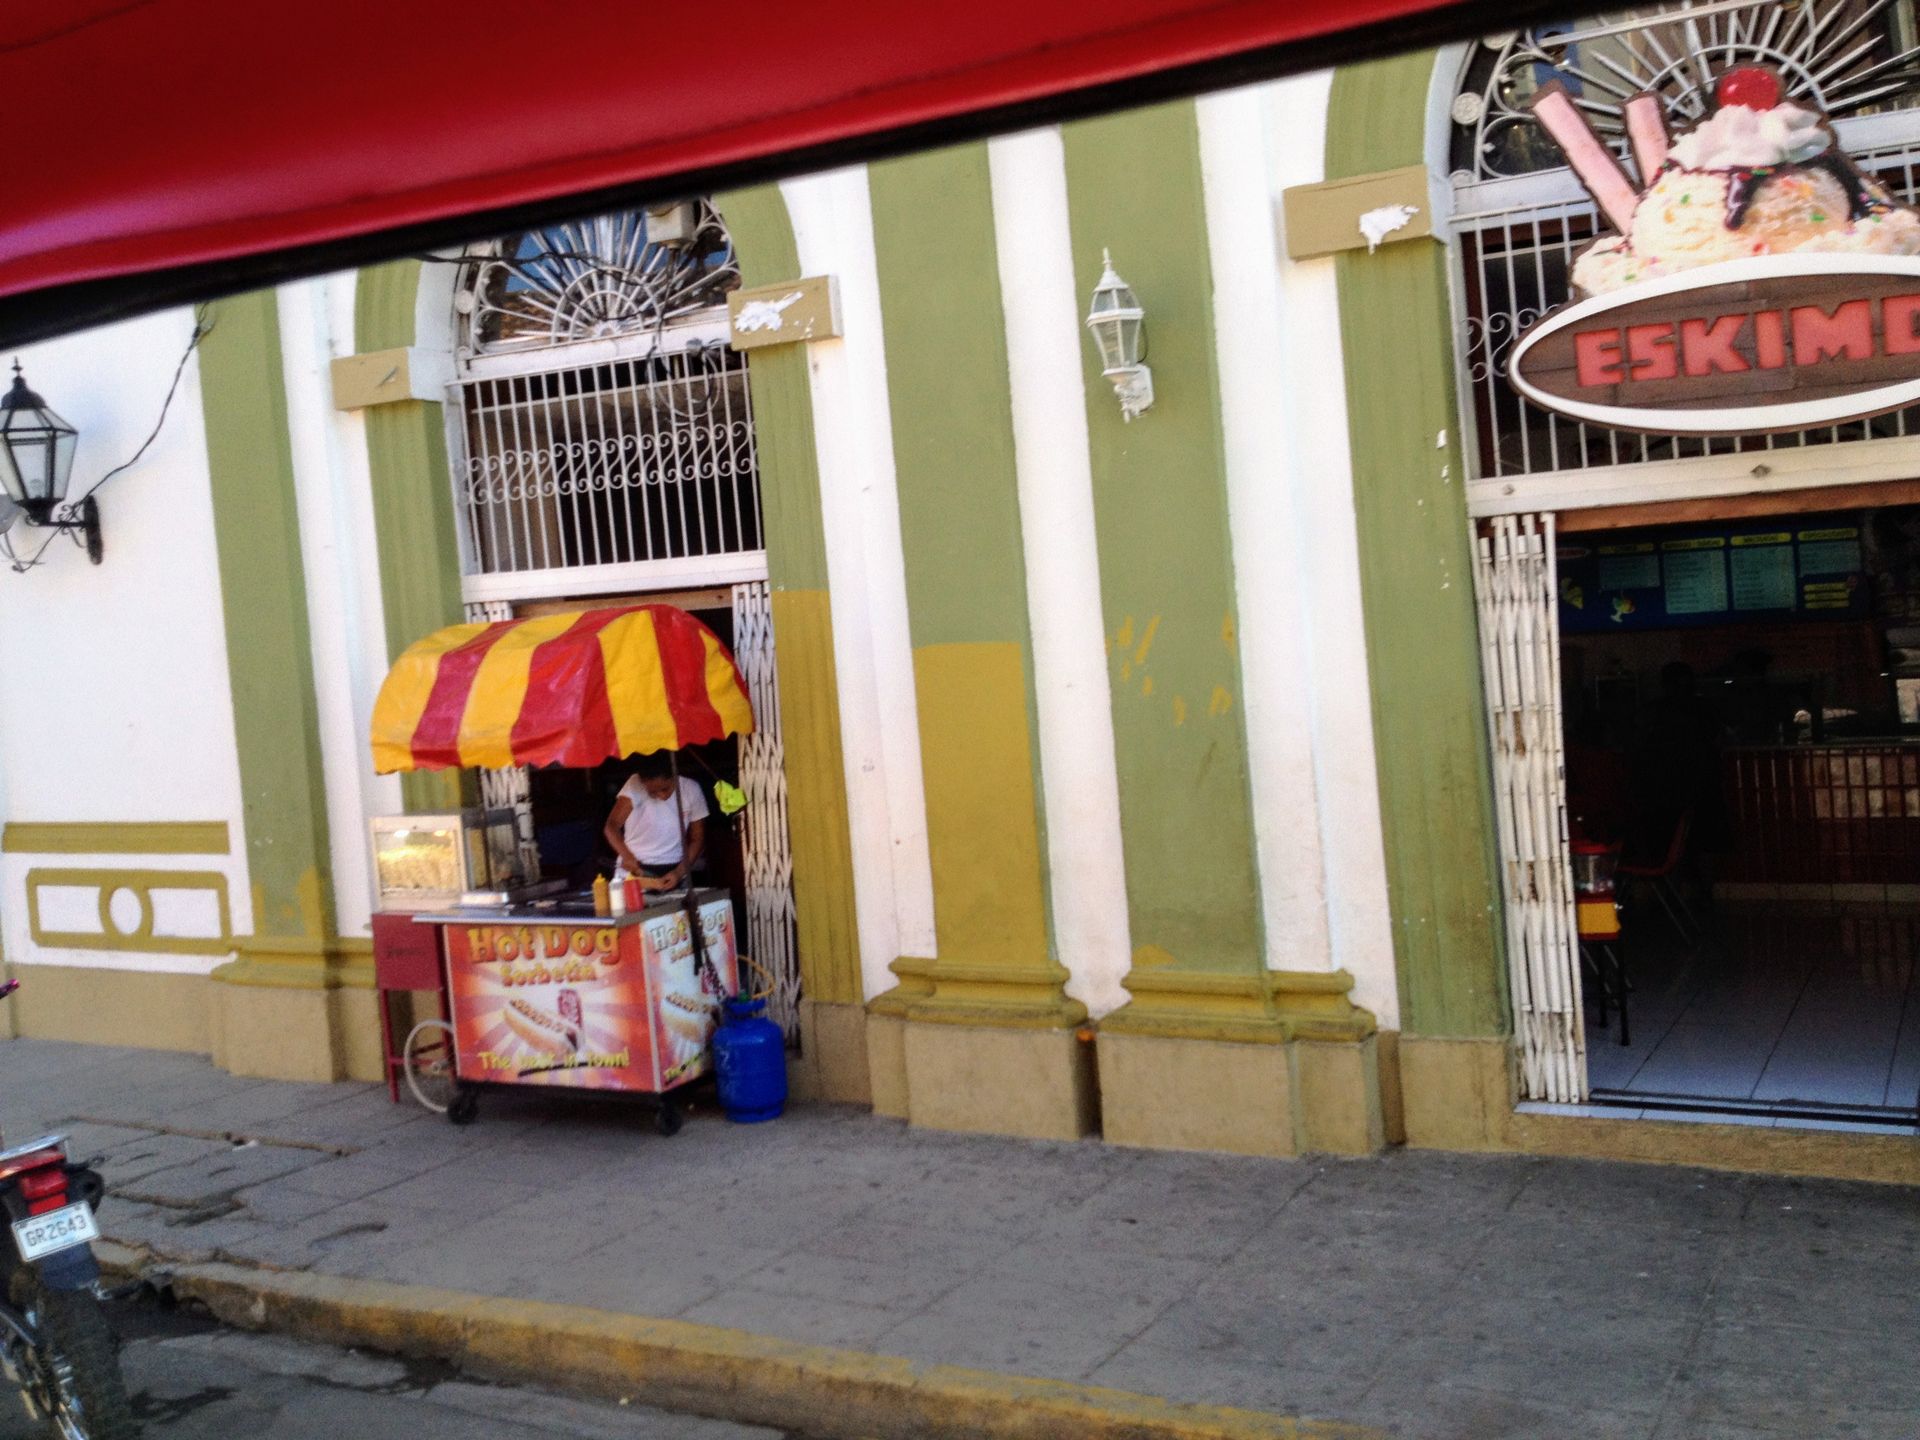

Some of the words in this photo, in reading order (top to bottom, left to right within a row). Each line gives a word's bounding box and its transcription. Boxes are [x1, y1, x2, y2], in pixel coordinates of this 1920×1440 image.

[467, 926, 535, 963] Hot
[538, 925, 621, 965] Dog
[477, 1051, 511, 1071] The
